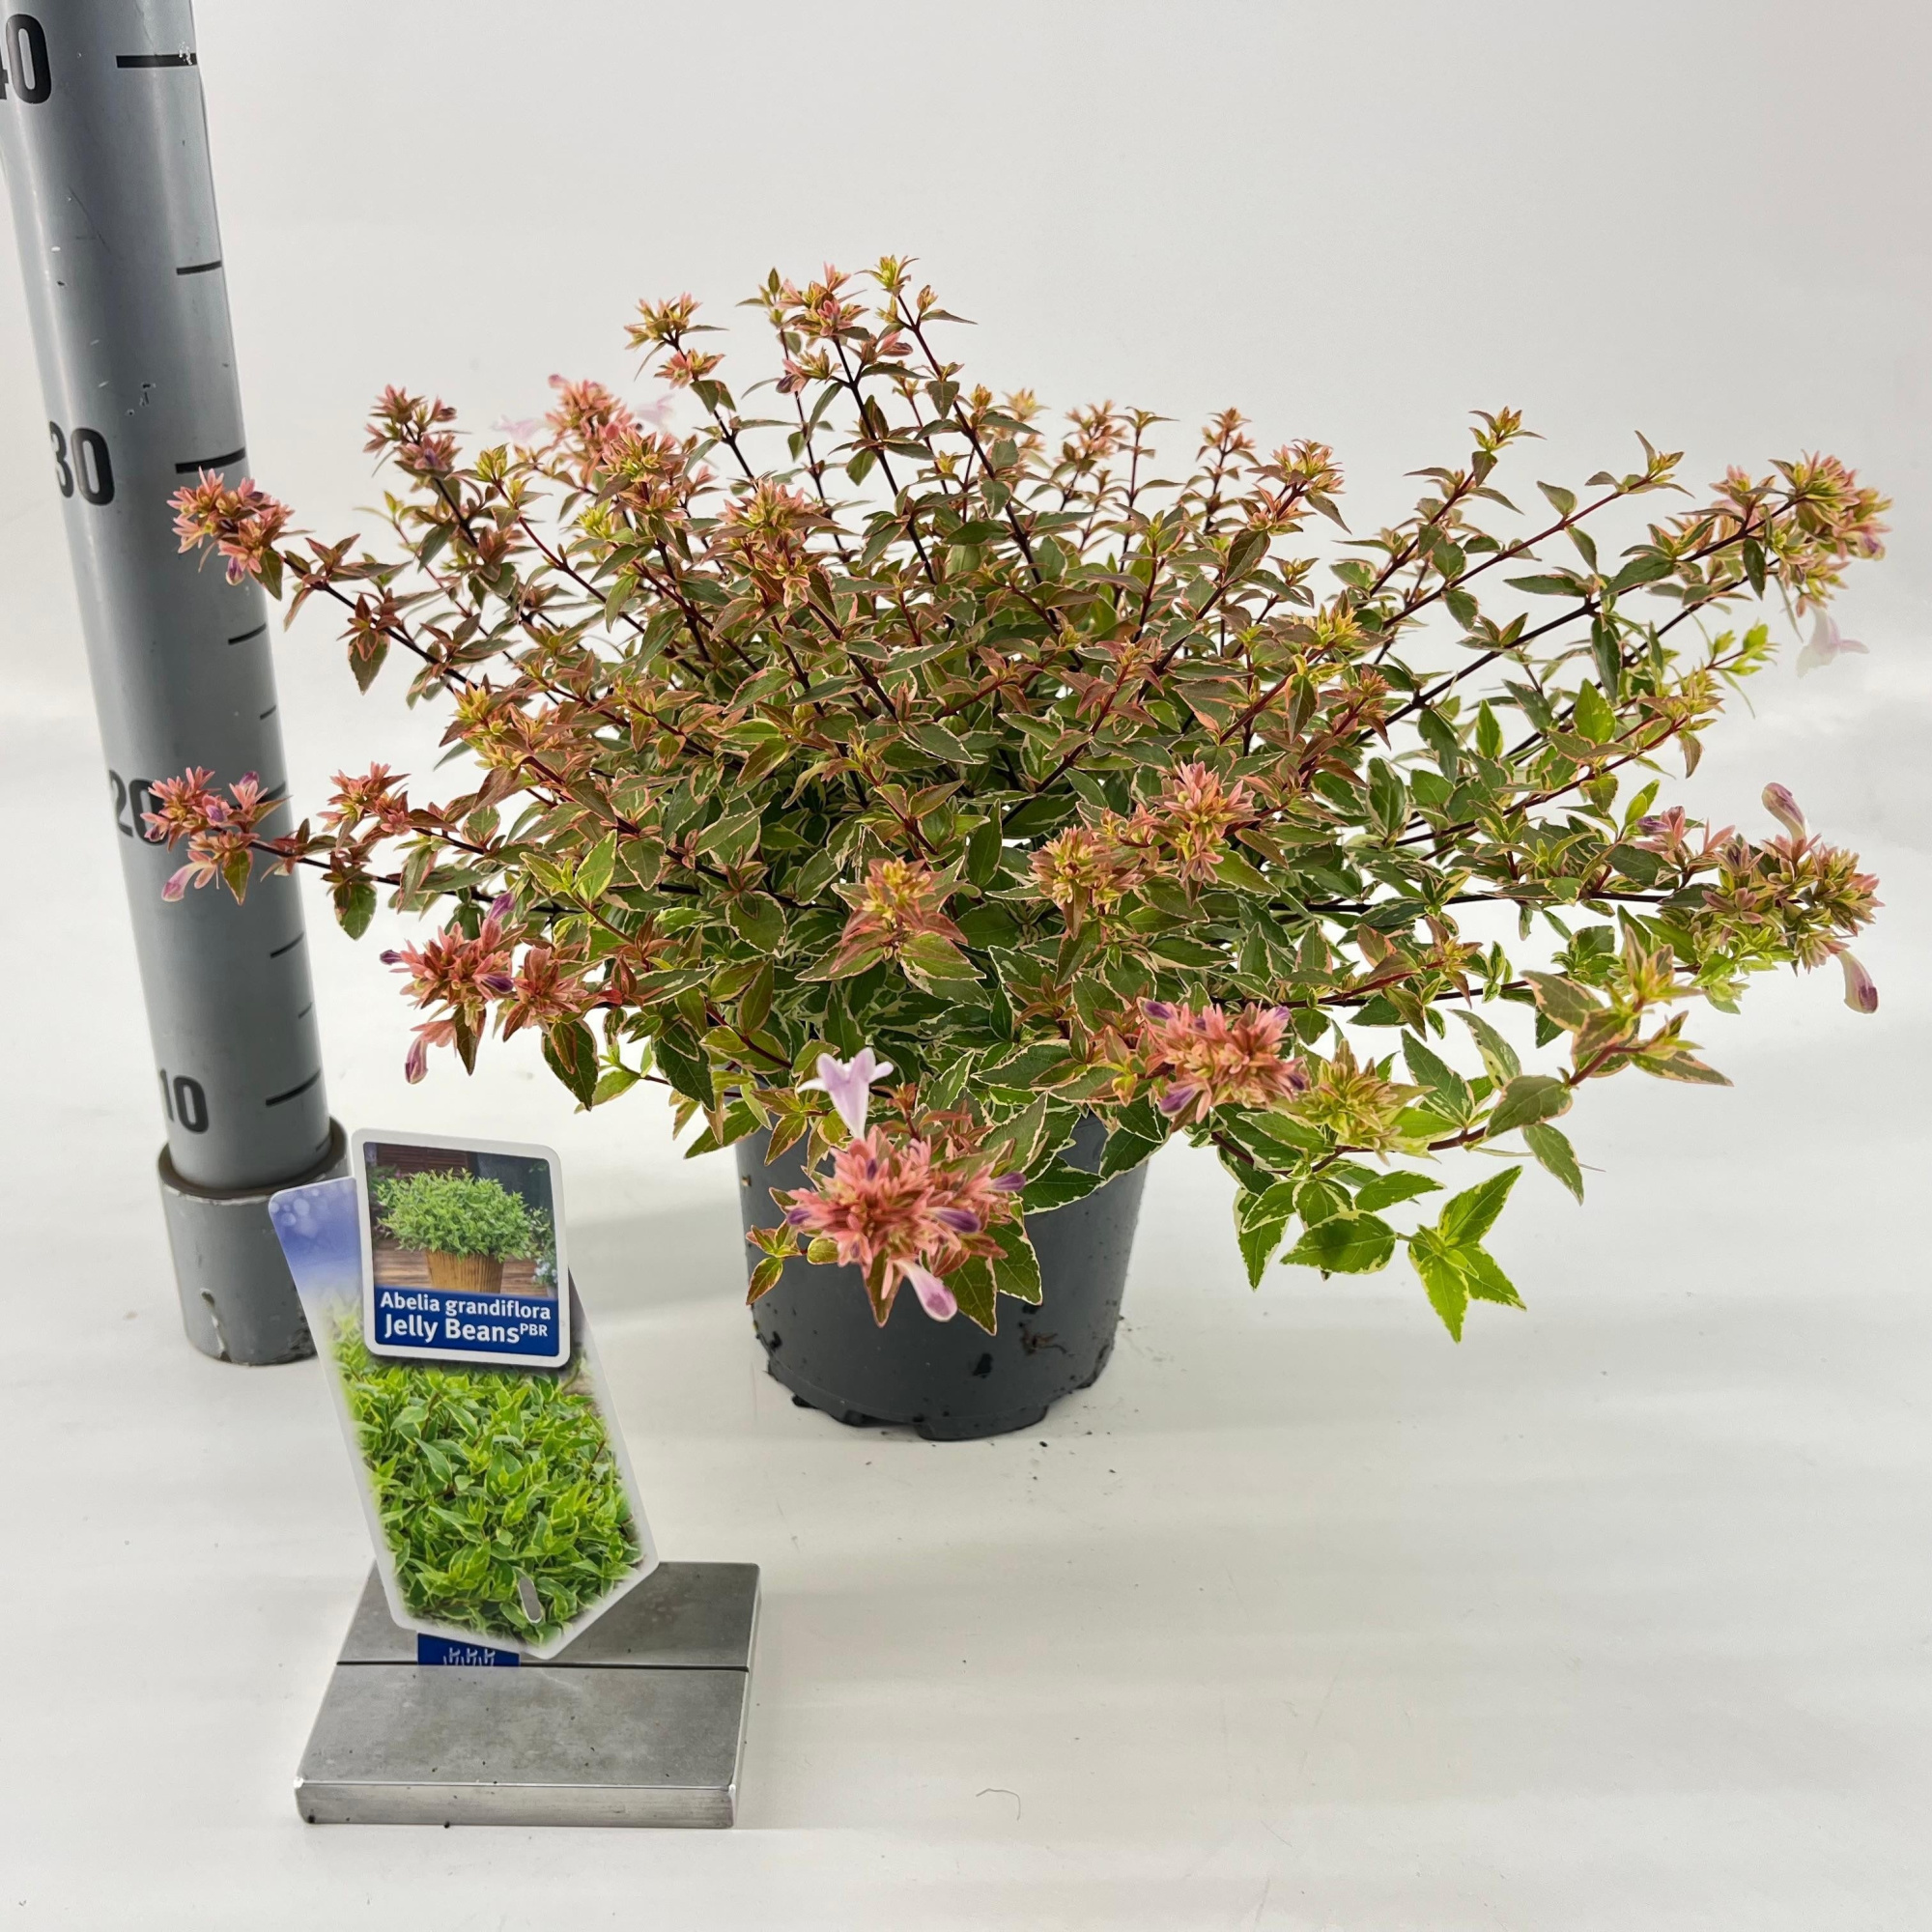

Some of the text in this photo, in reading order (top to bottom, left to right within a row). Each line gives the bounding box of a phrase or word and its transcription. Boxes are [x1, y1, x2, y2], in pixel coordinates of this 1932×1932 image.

[0, 14, 51, 104] 0
[49, 420, 115, 506] 30
[159, 1068, 210, 1134] 10
[380, 1292, 552, 1321] Abelia grandiflora
[384, 1314, 439, 1344] Jelly
